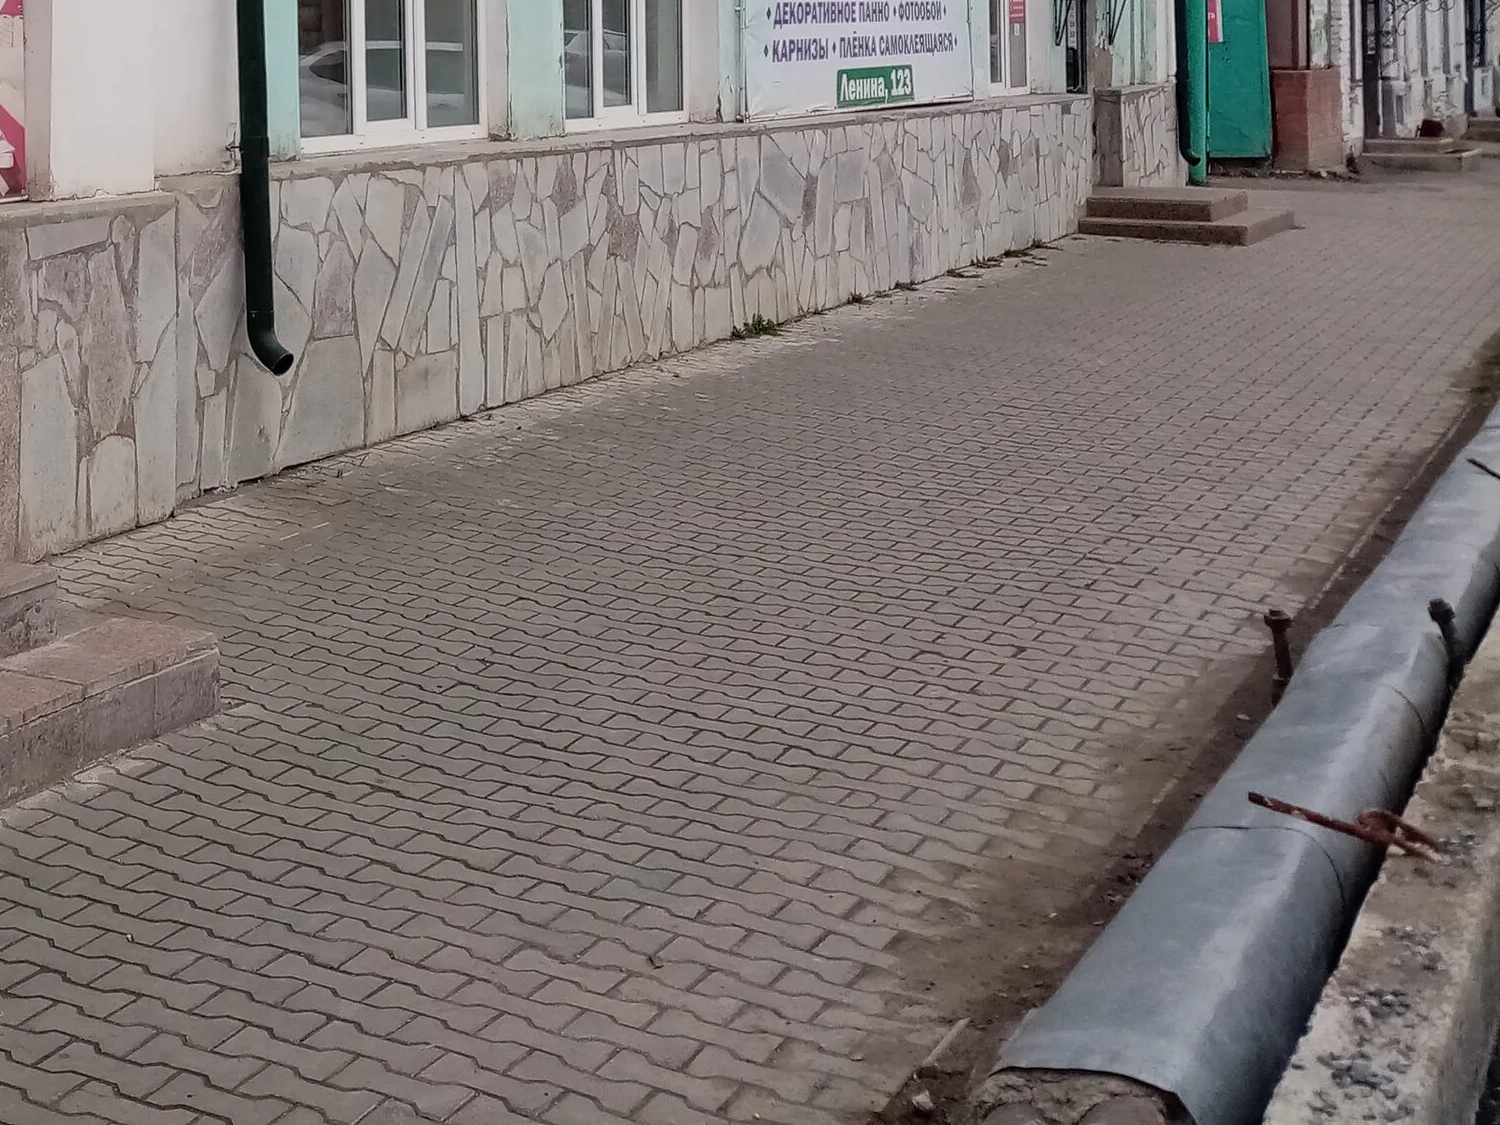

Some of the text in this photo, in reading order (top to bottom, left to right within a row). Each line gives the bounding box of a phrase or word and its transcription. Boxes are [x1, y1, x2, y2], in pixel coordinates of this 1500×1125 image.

[773, 0, 942, 28] ДЕКОРАТИВНОЕ ПАННО ФОТООБОИ
[772, 31, 954, 63] КАРНИЗЫ ПЛЁНКА САМОКЛЕЯЩАЯСЯ
[840, 69, 912, 103] Ленина, 123
